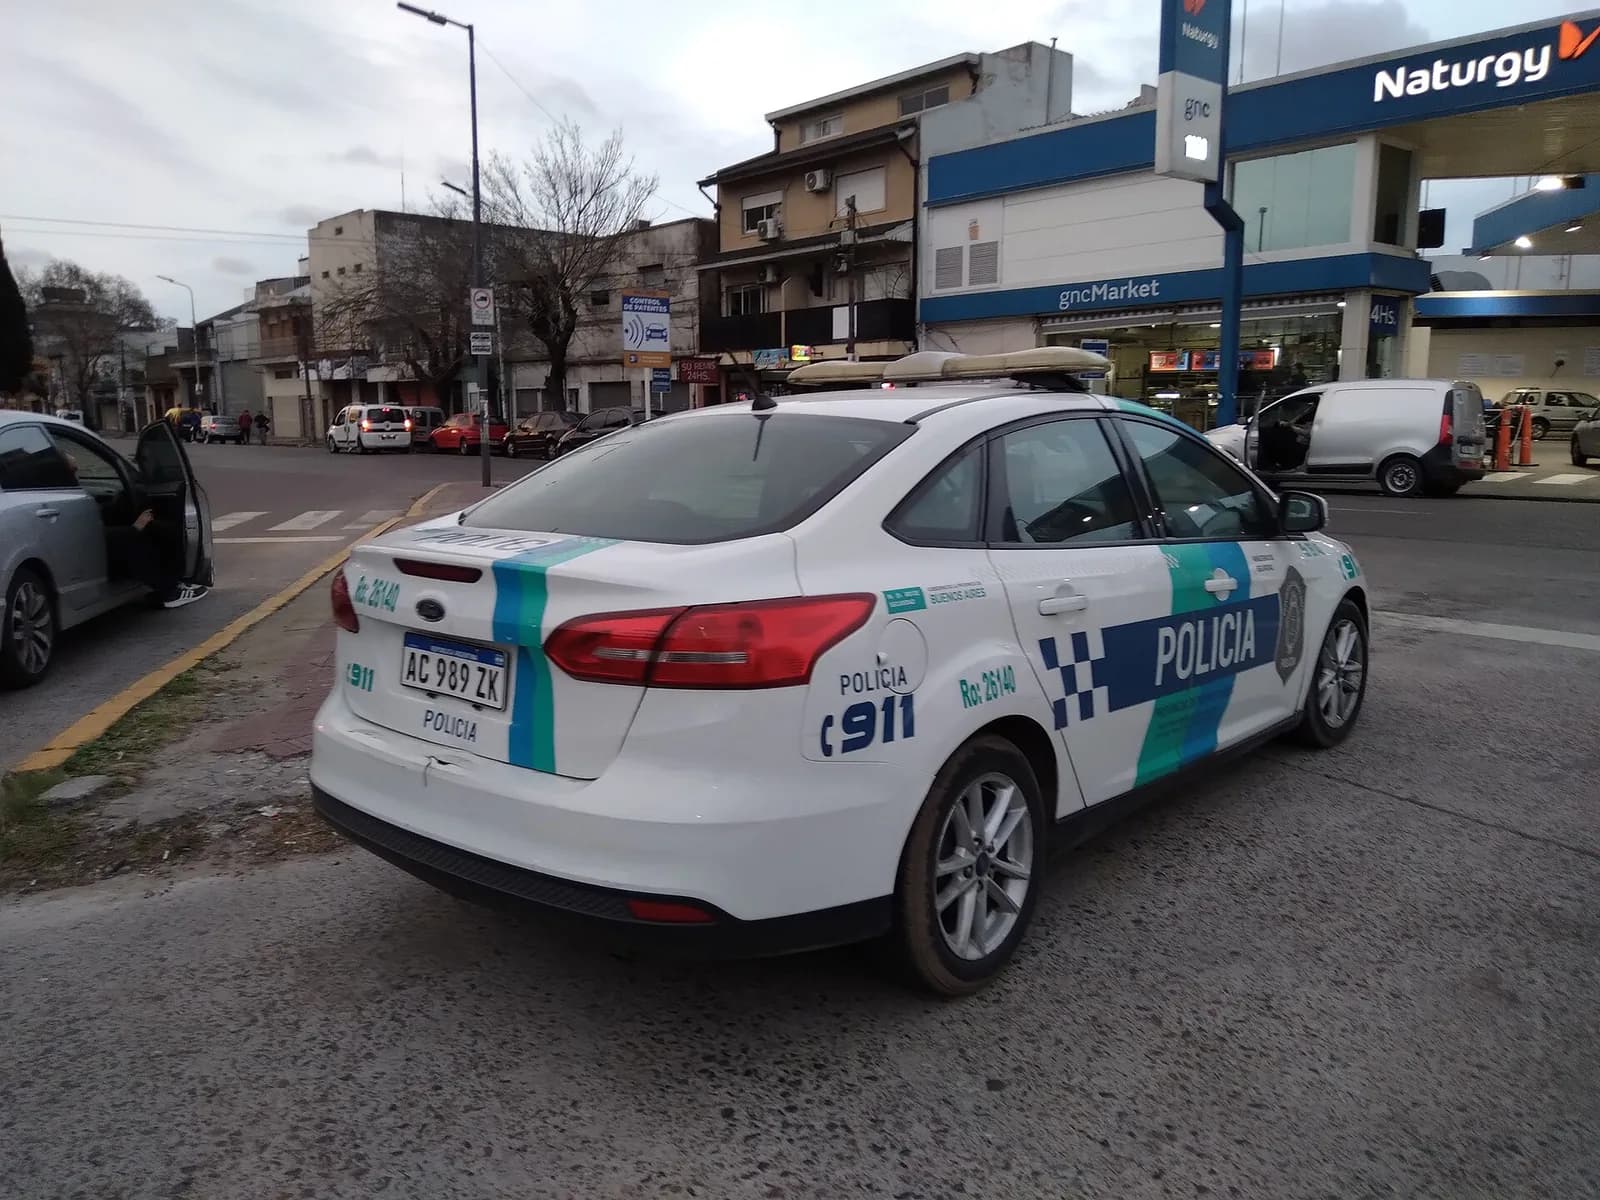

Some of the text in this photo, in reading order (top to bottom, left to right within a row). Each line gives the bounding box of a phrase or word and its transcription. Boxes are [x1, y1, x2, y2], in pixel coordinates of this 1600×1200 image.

[1182, 22, 1219, 49] Naturgy
[1373, 44, 1551, 102] Naturgy
[1184, 98, 1210, 121] gnc
[623, 303, 668, 313] DE PATENTES
[629, 297, 661, 305] CONTROL
[1058, 279, 1160, 311] gncMarket
[1155, 609, 1255, 686] POLICIA
[351, 663, 374, 692] 911
[406, 652, 430, 684] AC
[436, 658, 470, 693] 989
[476, 666, 499, 702] ZK
[840, 666, 908, 695] POLICIA
[981, 664, 1016, 702] 26140
[423, 709, 478, 742] POLICIA
[841, 694, 915, 754] 911
